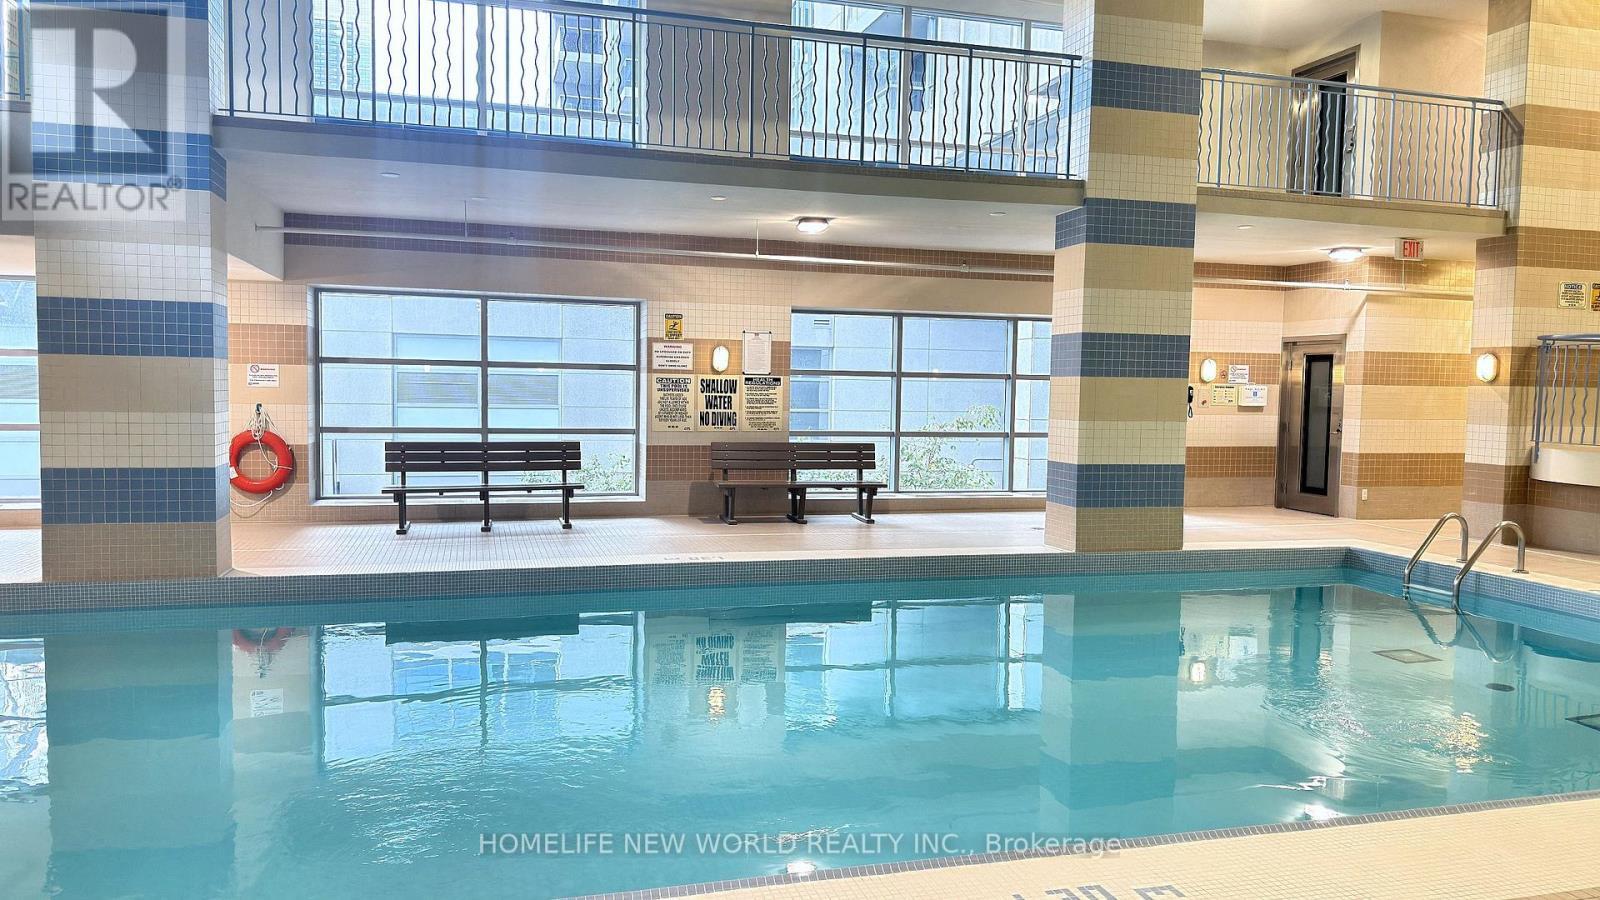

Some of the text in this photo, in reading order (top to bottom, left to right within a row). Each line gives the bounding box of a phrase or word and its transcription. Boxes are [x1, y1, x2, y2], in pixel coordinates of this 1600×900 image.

[1403, 240, 1420, 258] EXIT
[700, 378, 737, 394] SHALLOW
[705, 395, 732, 410] WATER
[700, 411, 737, 427] NO DIVING
